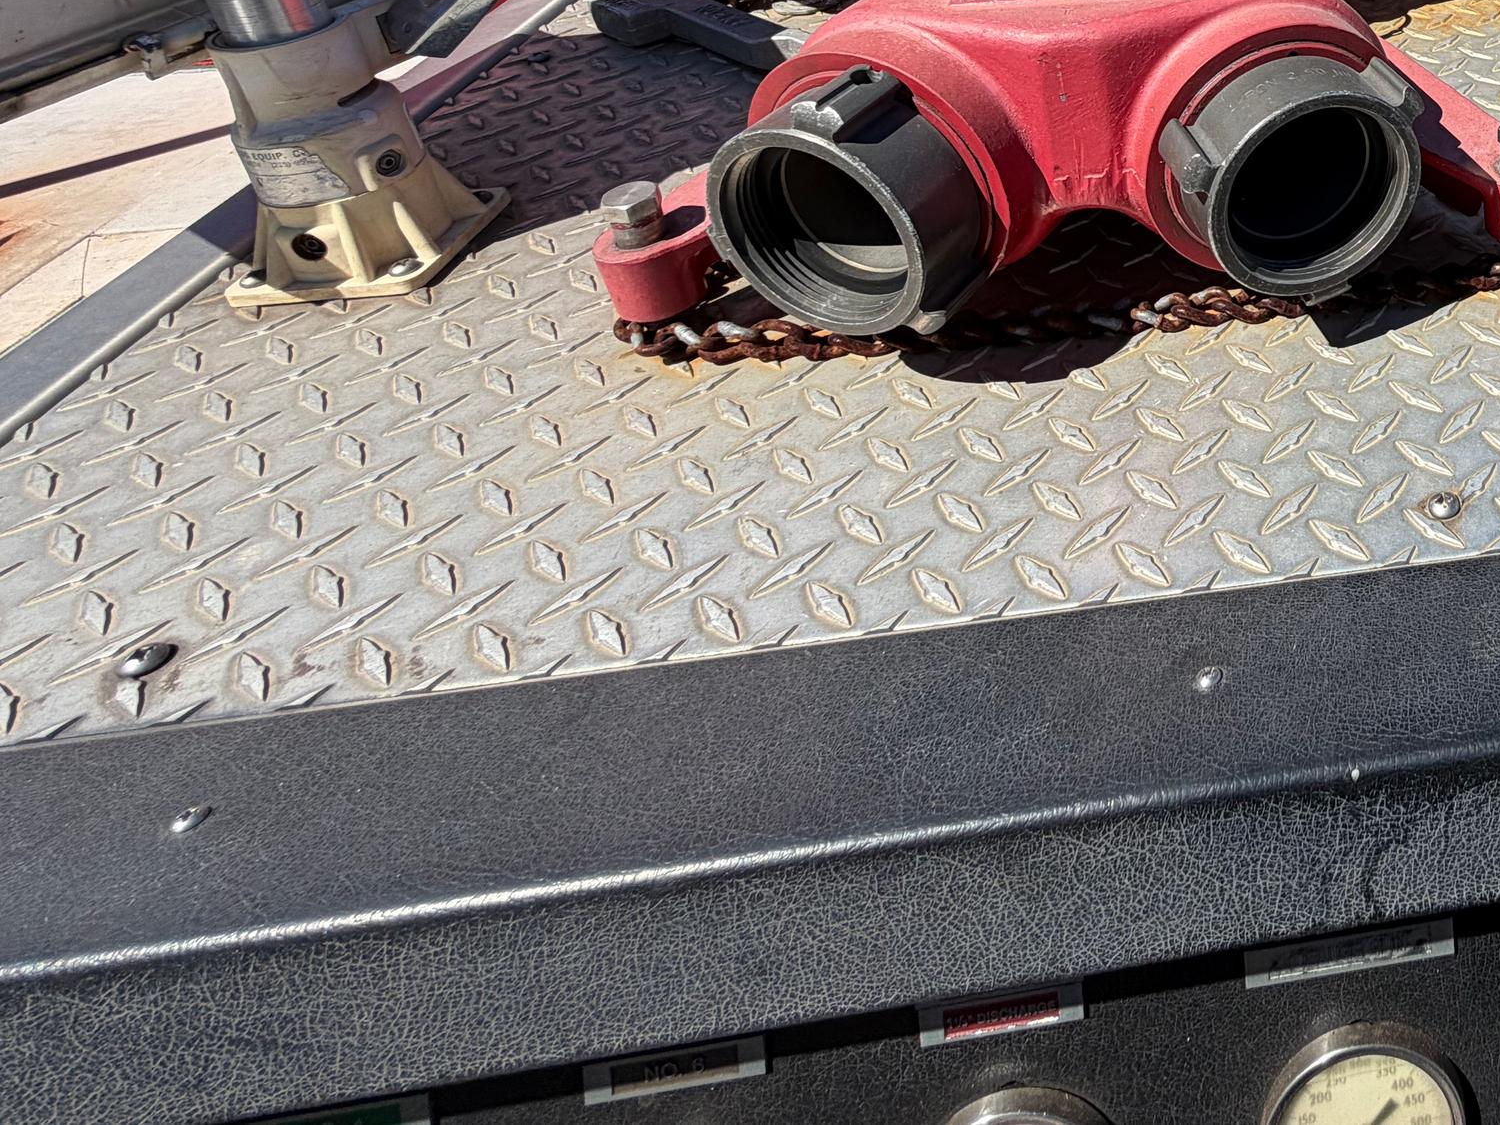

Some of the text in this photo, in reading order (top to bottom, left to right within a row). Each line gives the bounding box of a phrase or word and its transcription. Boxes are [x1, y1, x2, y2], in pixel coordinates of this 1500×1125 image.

[976, 1001, 1058, 1024] DISCHARGE
[1391, 1077, 1414, 1091] 400
[1309, 1091, 1332, 1106] 200
[1403, 1093, 1425, 1107] 450
[1410, 1114, 1432, 1125] 500
